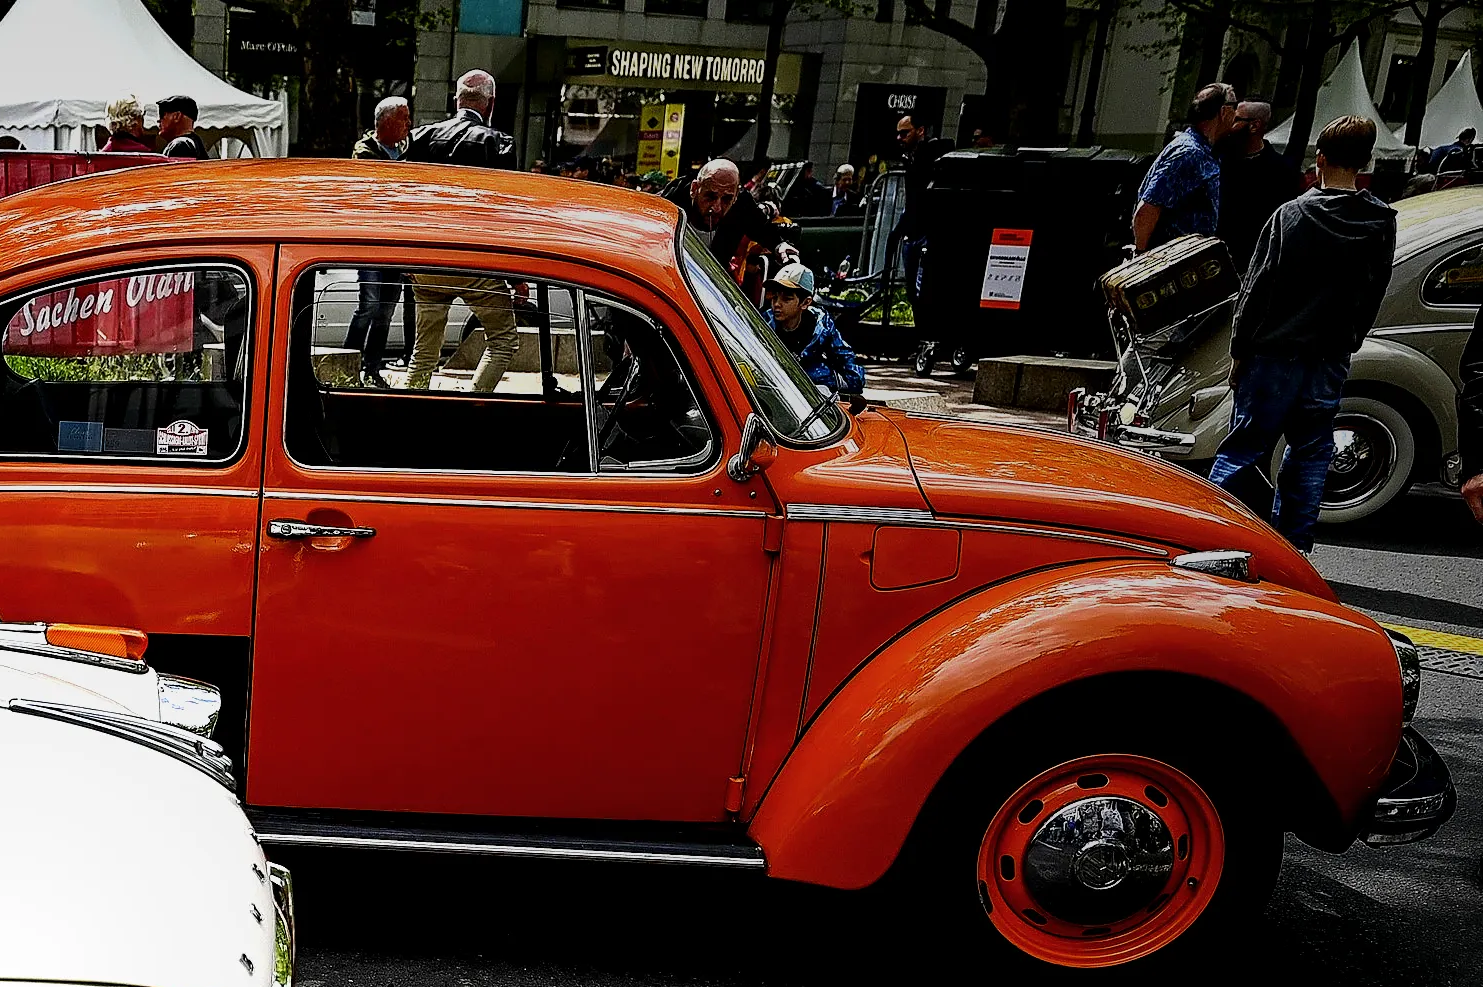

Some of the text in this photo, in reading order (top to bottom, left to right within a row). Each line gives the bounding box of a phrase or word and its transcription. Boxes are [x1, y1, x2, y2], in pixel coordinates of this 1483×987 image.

[611, 50, 671, 79] SHAPING
[674, 55, 704, 80] NEW
[706, 57, 765, 84] TOMORRO
[20, 287, 114, 337] Sachen
